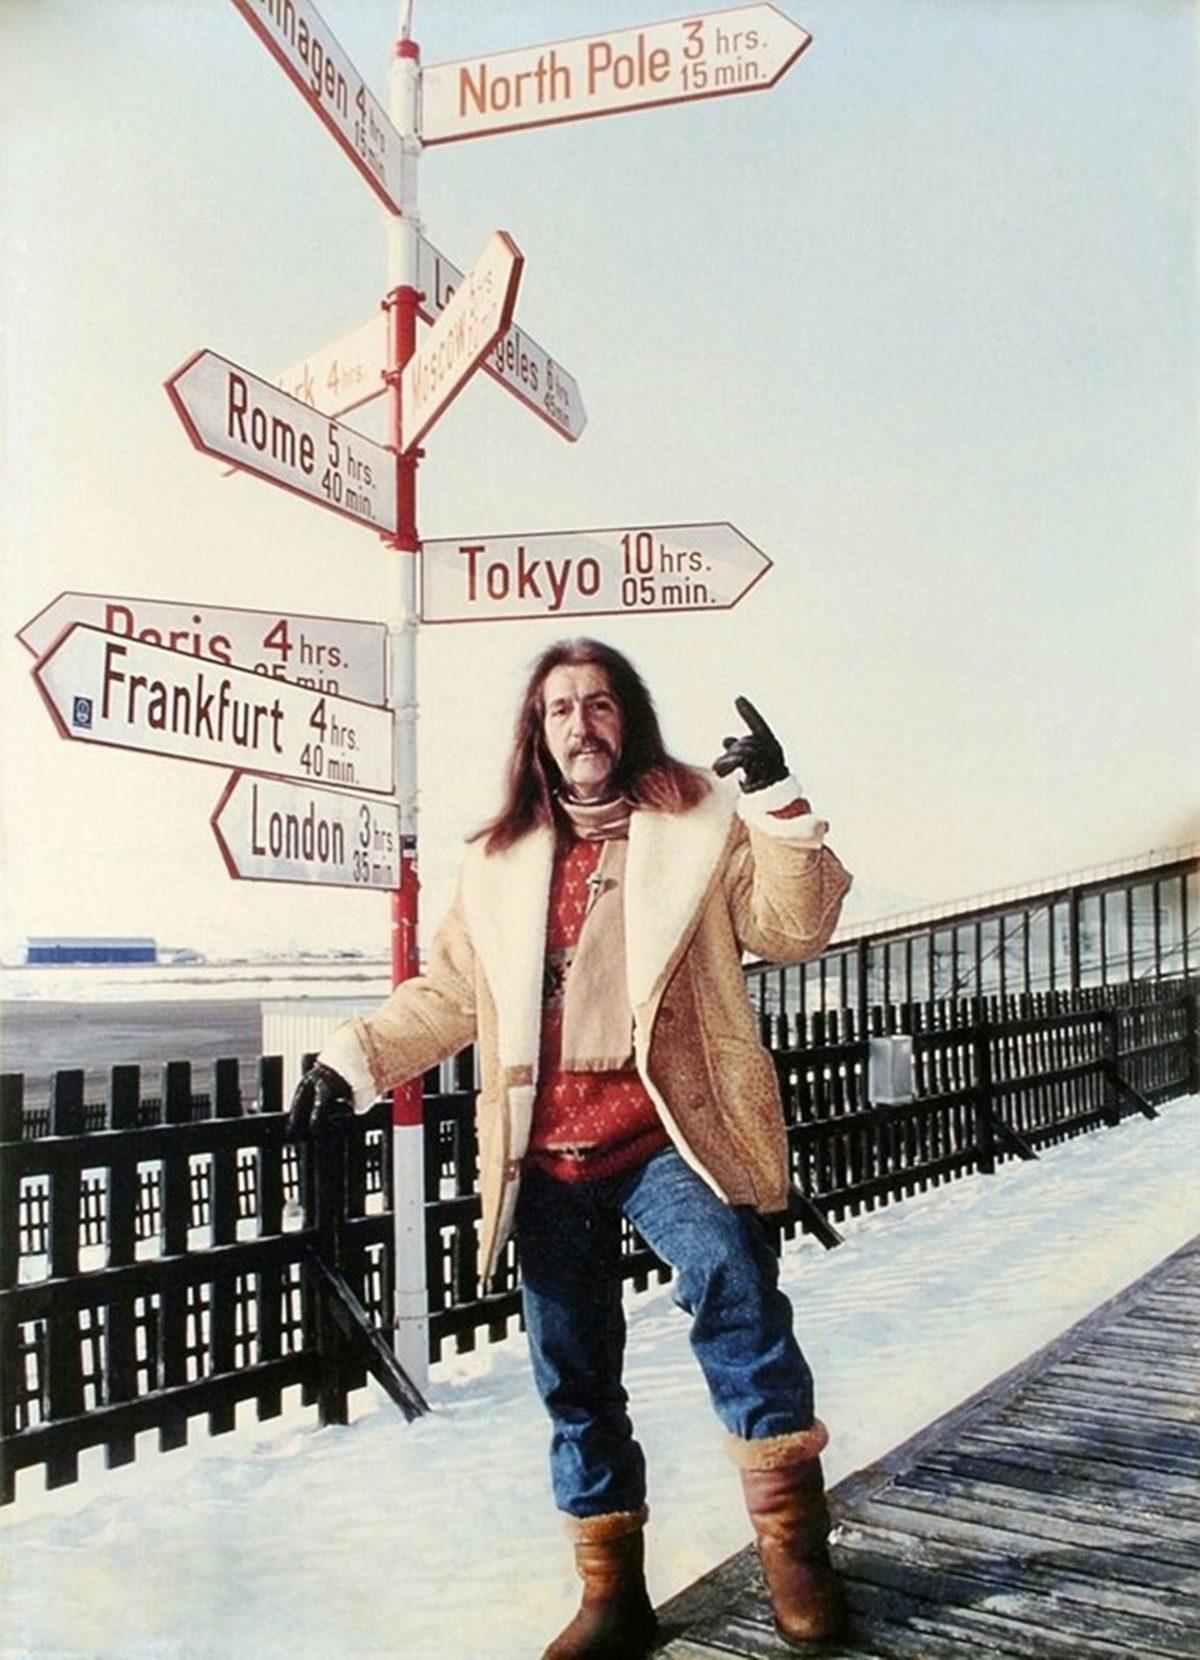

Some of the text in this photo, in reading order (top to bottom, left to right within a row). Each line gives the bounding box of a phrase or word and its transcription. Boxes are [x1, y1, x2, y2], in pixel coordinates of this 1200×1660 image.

[682, 20, 767, 60] 3 hrs.
[459, 34, 670, 117] North Pole
[681, 57, 767, 91] 15 min.
[227, 371, 315, 476] Rome
[328, 422, 376, 489] 5 hrs.
[321, 468, 376, 520] 40 min.
[458, 545, 600, 611] Tokyo
[620, 532, 712, 575] 10 hrs.
[621, 576, 716, 607] 05 min.
[262, 619, 349, 669] 4 hrs.
[101, 641, 284, 753] Frankfurt
[309, 697, 360, 751] 4 hrs.
[299, 742, 360, 785] 40 min.
[252, 783, 345, 865] London
[359, 804, 371, 849] 3
[353, 849, 370, 883] 35
